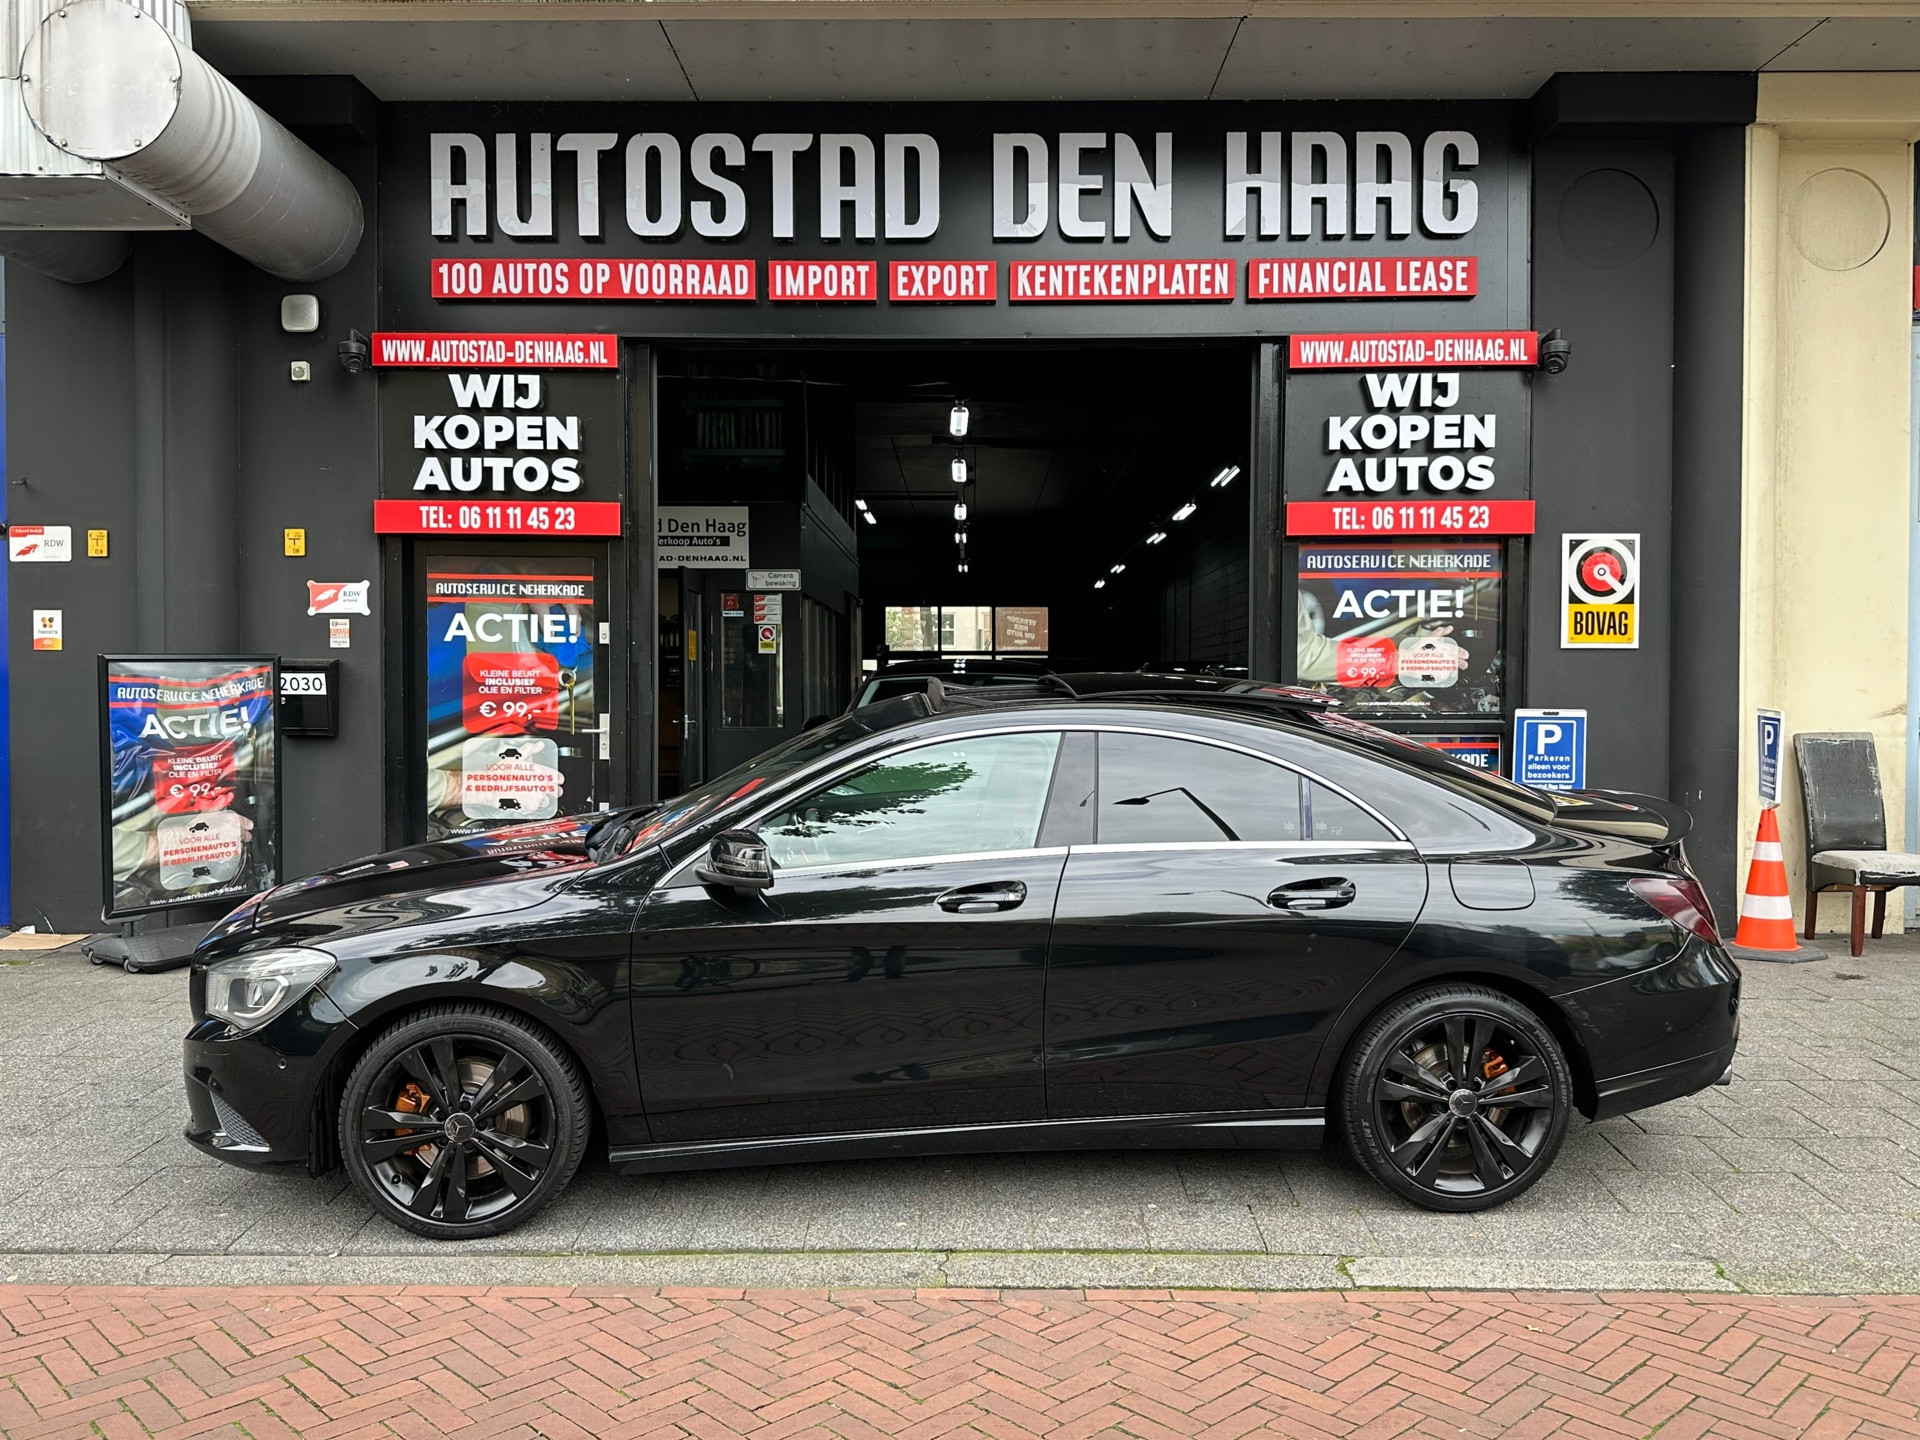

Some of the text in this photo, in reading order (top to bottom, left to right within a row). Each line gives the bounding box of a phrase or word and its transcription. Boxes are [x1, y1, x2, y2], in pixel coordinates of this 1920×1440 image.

[430, 131, 1480, 239] AUTOSTAD DEN HAAG
[438, 263, 750, 296] 100 AUTOS OP VOORRAAD
[775, 264, 870, 296] IMPORT
[897, 264, 989, 296] EXPORT
[1017, 263, 1229, 296] KENTEKENPLATEN
[1258, 260, 1469, 296] FINANCIAL LEASE
[382, 340, 608, 365] WWW.AUTOSTAD-DENHAAG.NL
[1300, 339, 1528, 364] WWW.AUTOSTAD-DENHAAG.NL
[448, 373, 542, 410] WIJ
[1365, 373, 1460, 408] WIJ
[413, 415, 580, 450] KOPEN
[1328, 414, 1496, 450] KOPEN
[413, 456, 581, 493] AUTOS
[1326, 456, 1496, 493] AUTOS
[420, 506, 575, 530] TEL: 06 11 11 45 23
[668, 518, 700, 533] Den
[706, 518, 747, 537] Haag
[1333, 505, 1490, 530] TEL: 06 11 11 45 23
[44, 539, 64, 547] RDW
[658, 536, 721, 546] erkoop Auto's
[1307, 554, 1492, 569] AUTOSERVICE NEHERKADE
[436, 582, 585, 597] AUTOSERVICE NEHERKADE
[765, 580, 797, 588] bewaking
[1332, 589, 1465, 619] ACTIE!
[443, 612, 579, 644] ACTIE!
[1573, 610, 1629, 637] BOVAG
[281, 676, 323, 691] 2030
[480, 669, 540, 677] KLEINE BEURT
[1347, 667, 1385, 679] € 99,-
[117, 676, 266, 702] AUTOSERVICE NEHERKADE
[478, 686, 498, 694] OLIE
[500, 686, 512, 694] EN
[479, 701, 542, 720] € 99,-
[138, 705, 252, 740] ACTIE!
[1537, 723, 1563, 755] P
[1764, 724, 1774, 756] P
[168, 755, 223, 765] KLEINE BEURT
[173, 762, 219, 771] INCLUSIEF
[486, 763, 535, 771] VOOR ALLE
[1527, 754, 1571, 762] Parkeren
[168, 770, 186, 779] OLIE
[200, 769, 222, 778] FILTER
[467, 774, 553, 782] PERSONENAUTO'S
[1527, 771, 1570, 779] bezoekers
[170, 782, 223, 798] € 99,-
[475, 785, 555, 793] BEDRIJFSAUTO'S
[163, 840, 237, 857] PERSONENAUTO'S
[179, 833, 221, 845] VOOR ALLE
[171, 849, 240, 866] BEDRIJFSAUTO'S
